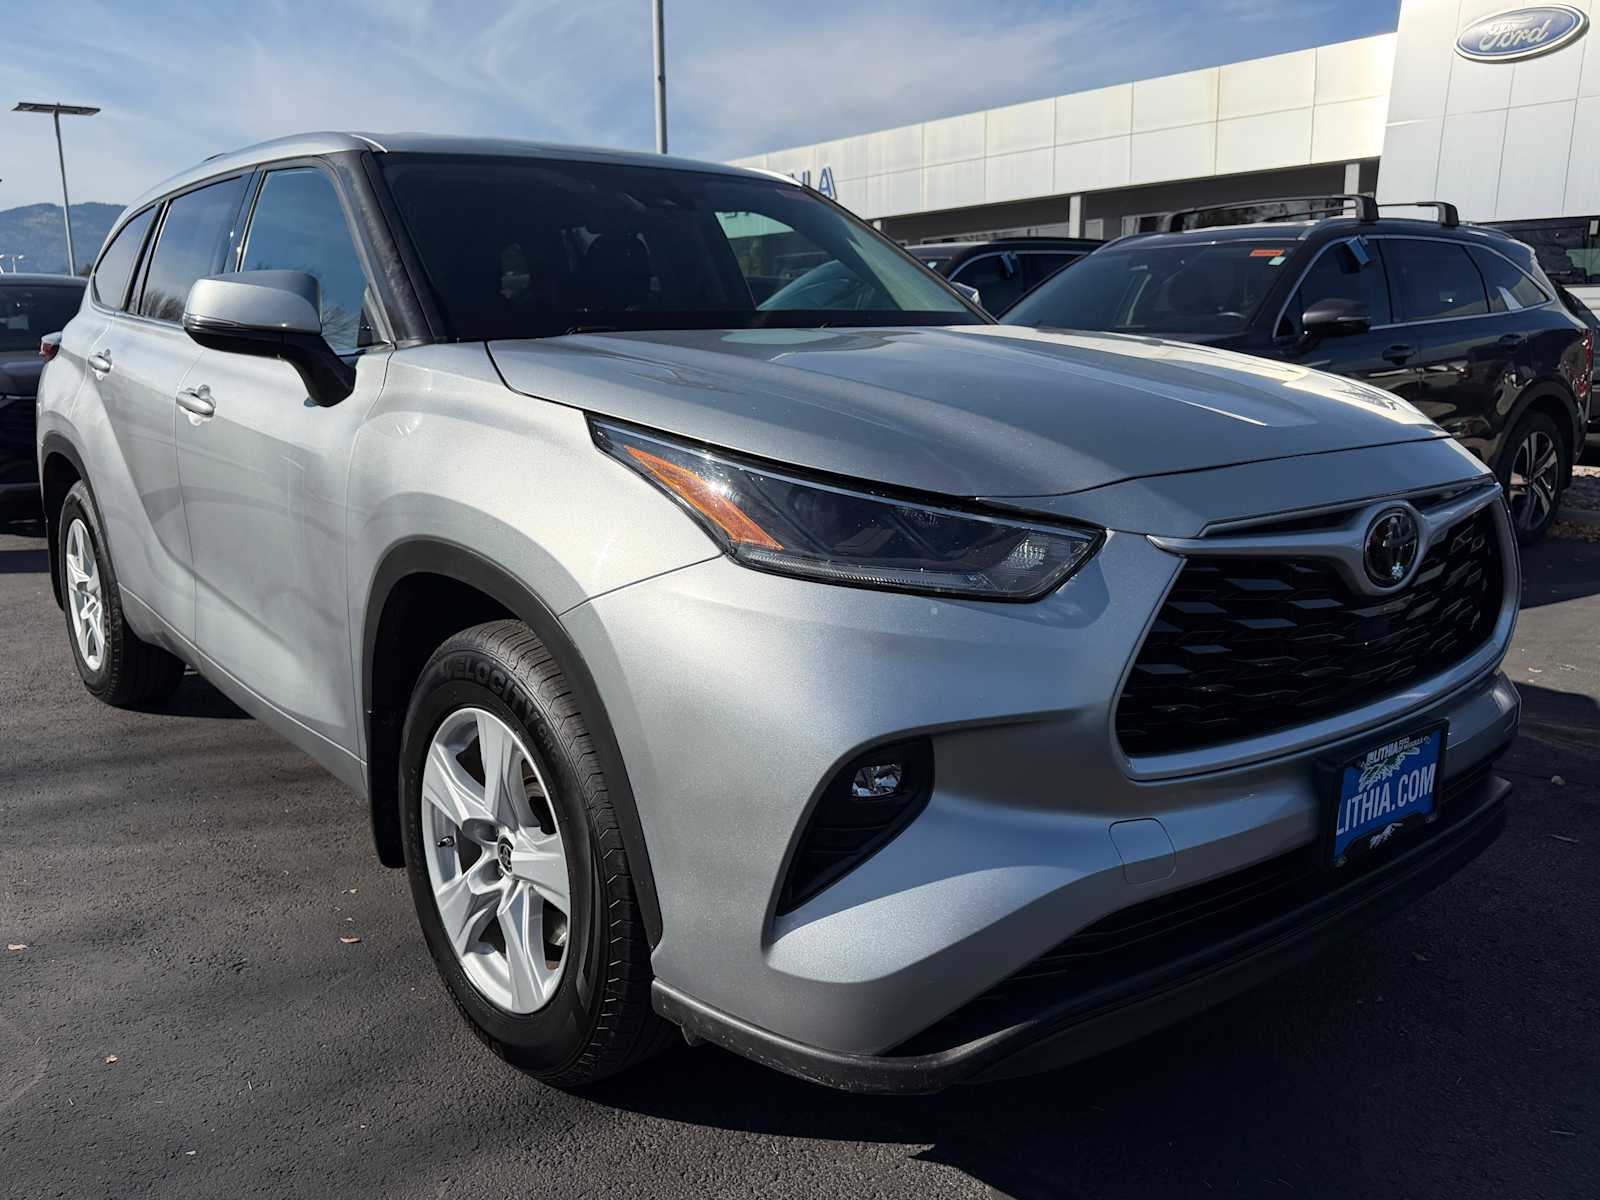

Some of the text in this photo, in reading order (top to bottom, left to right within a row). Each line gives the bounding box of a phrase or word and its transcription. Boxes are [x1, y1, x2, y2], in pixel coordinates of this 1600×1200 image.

[1478, 16, 1552, 51] Ford
[790, 166, 837, 199] IA
[1336, 763, 1437, 836] LITHIA.COM
